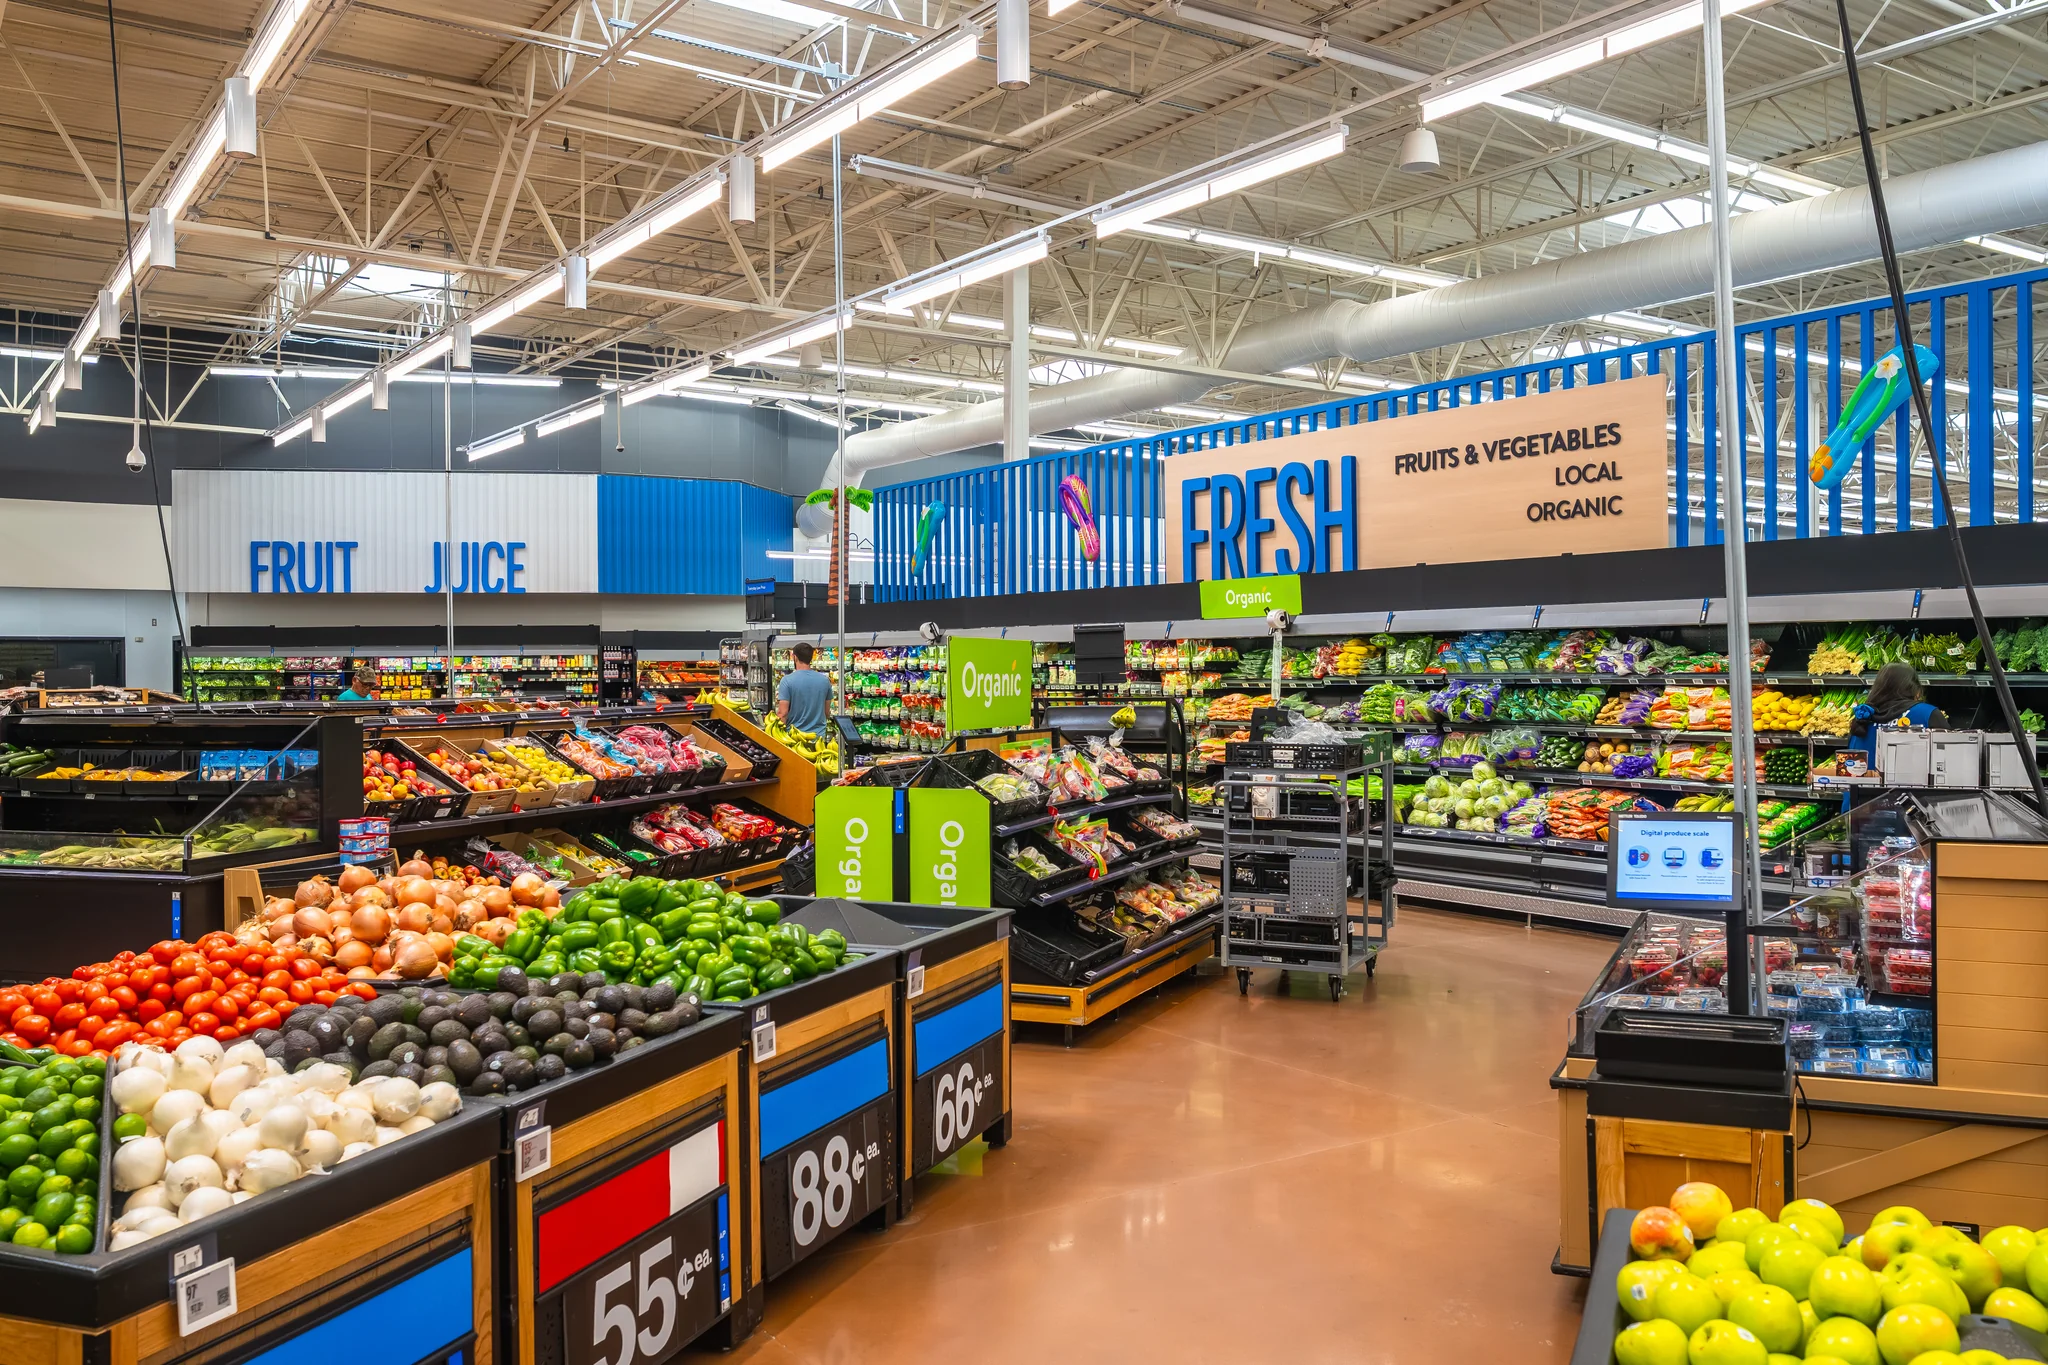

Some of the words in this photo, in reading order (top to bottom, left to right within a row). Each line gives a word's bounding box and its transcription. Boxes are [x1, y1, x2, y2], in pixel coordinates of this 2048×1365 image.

[1395, 447, 1459, 475] FRUITS
[1464, 444, 1479, 465] &
[1482, 423, 1622, 462] VEGETABLES
[1555, 461, 1622, 486] LOCAL
[1182, 455, 1357, 583] FRESH
[1527, 495, 1623, 522] ORGANIC
[250, 541, 358, 593] FRUIT
[424, 541, 526, 593] JUICE
[1226, 586, 1272, 608] Organic
[962, 660, 1021, 708] Organic
[867, 1142, 880, 1160] ea.
[719, 1230, 726, 1240] AP
[694, 1249, 712, 1272] ea.
